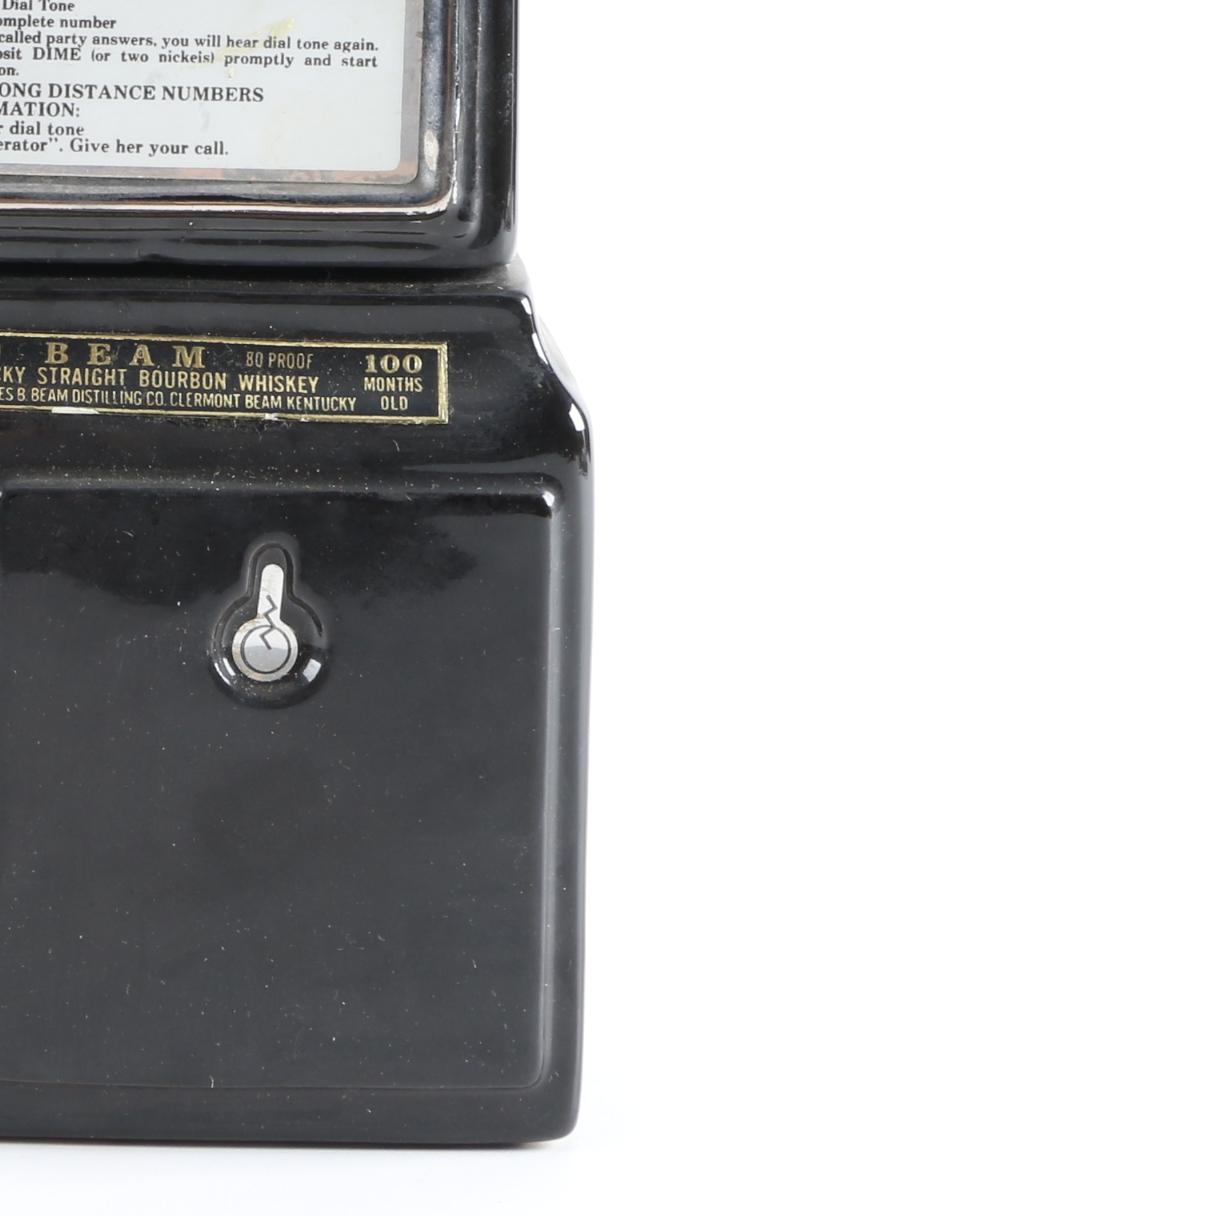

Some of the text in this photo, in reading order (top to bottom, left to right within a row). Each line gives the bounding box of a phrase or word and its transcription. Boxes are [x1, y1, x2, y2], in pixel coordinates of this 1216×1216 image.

[60, 16, 116, 29] number
[46, 33, 86, 47] party
[163, 37, 189, 48] you
[195, 35, 221, 48] will
[227, 36, 258, 48] hear
[263, 37, 290, 49] dial
[297, 38, 329, 50] tone
[334, 39, 378, 52] again.
[33, 47, 81, 60] DIME
[91, 49, 110, 62] (or
[121, 51, 149, 62] two
[224, 53, 294, 68] promptly
[304, 54, 331, 66] and
[341, 56, 378, 67] start
[48, 84, 156, 100] DISTANCE
[162, 86, 264, 102] NUMBERS
[9, 120, 40, 135] dial
[47, 122, 84, 136] tone
[70, 138, 109, 152] Give
[116, 139, 143, 153] her
[149, 143, 189, 157] your
[194, 141, 228, 155] call.
[44, 342, 206, 368] BEAM
[246, 352, 314, 369] 80 PROOF
[364, 354, 423, 373] 100
[37, 367, 127, 386] STRAIGHT
[139, 370, 226, 390] BOURBON
[238, 374, 319, 393] WHISKEY
[364, 377, 423, 392] MONTHS
[32, 388, 67, 402] BEAM
[73, 389, 142, 405] DISTILLING
[147, 391, 166, 406] CO.
[170, 392, 240, 408] CLERMONT
[245, 395, 281, 409] BEAM
[287, 396, 357, 411] KENTUCKY
[380, 396, 409, 411] OLD
